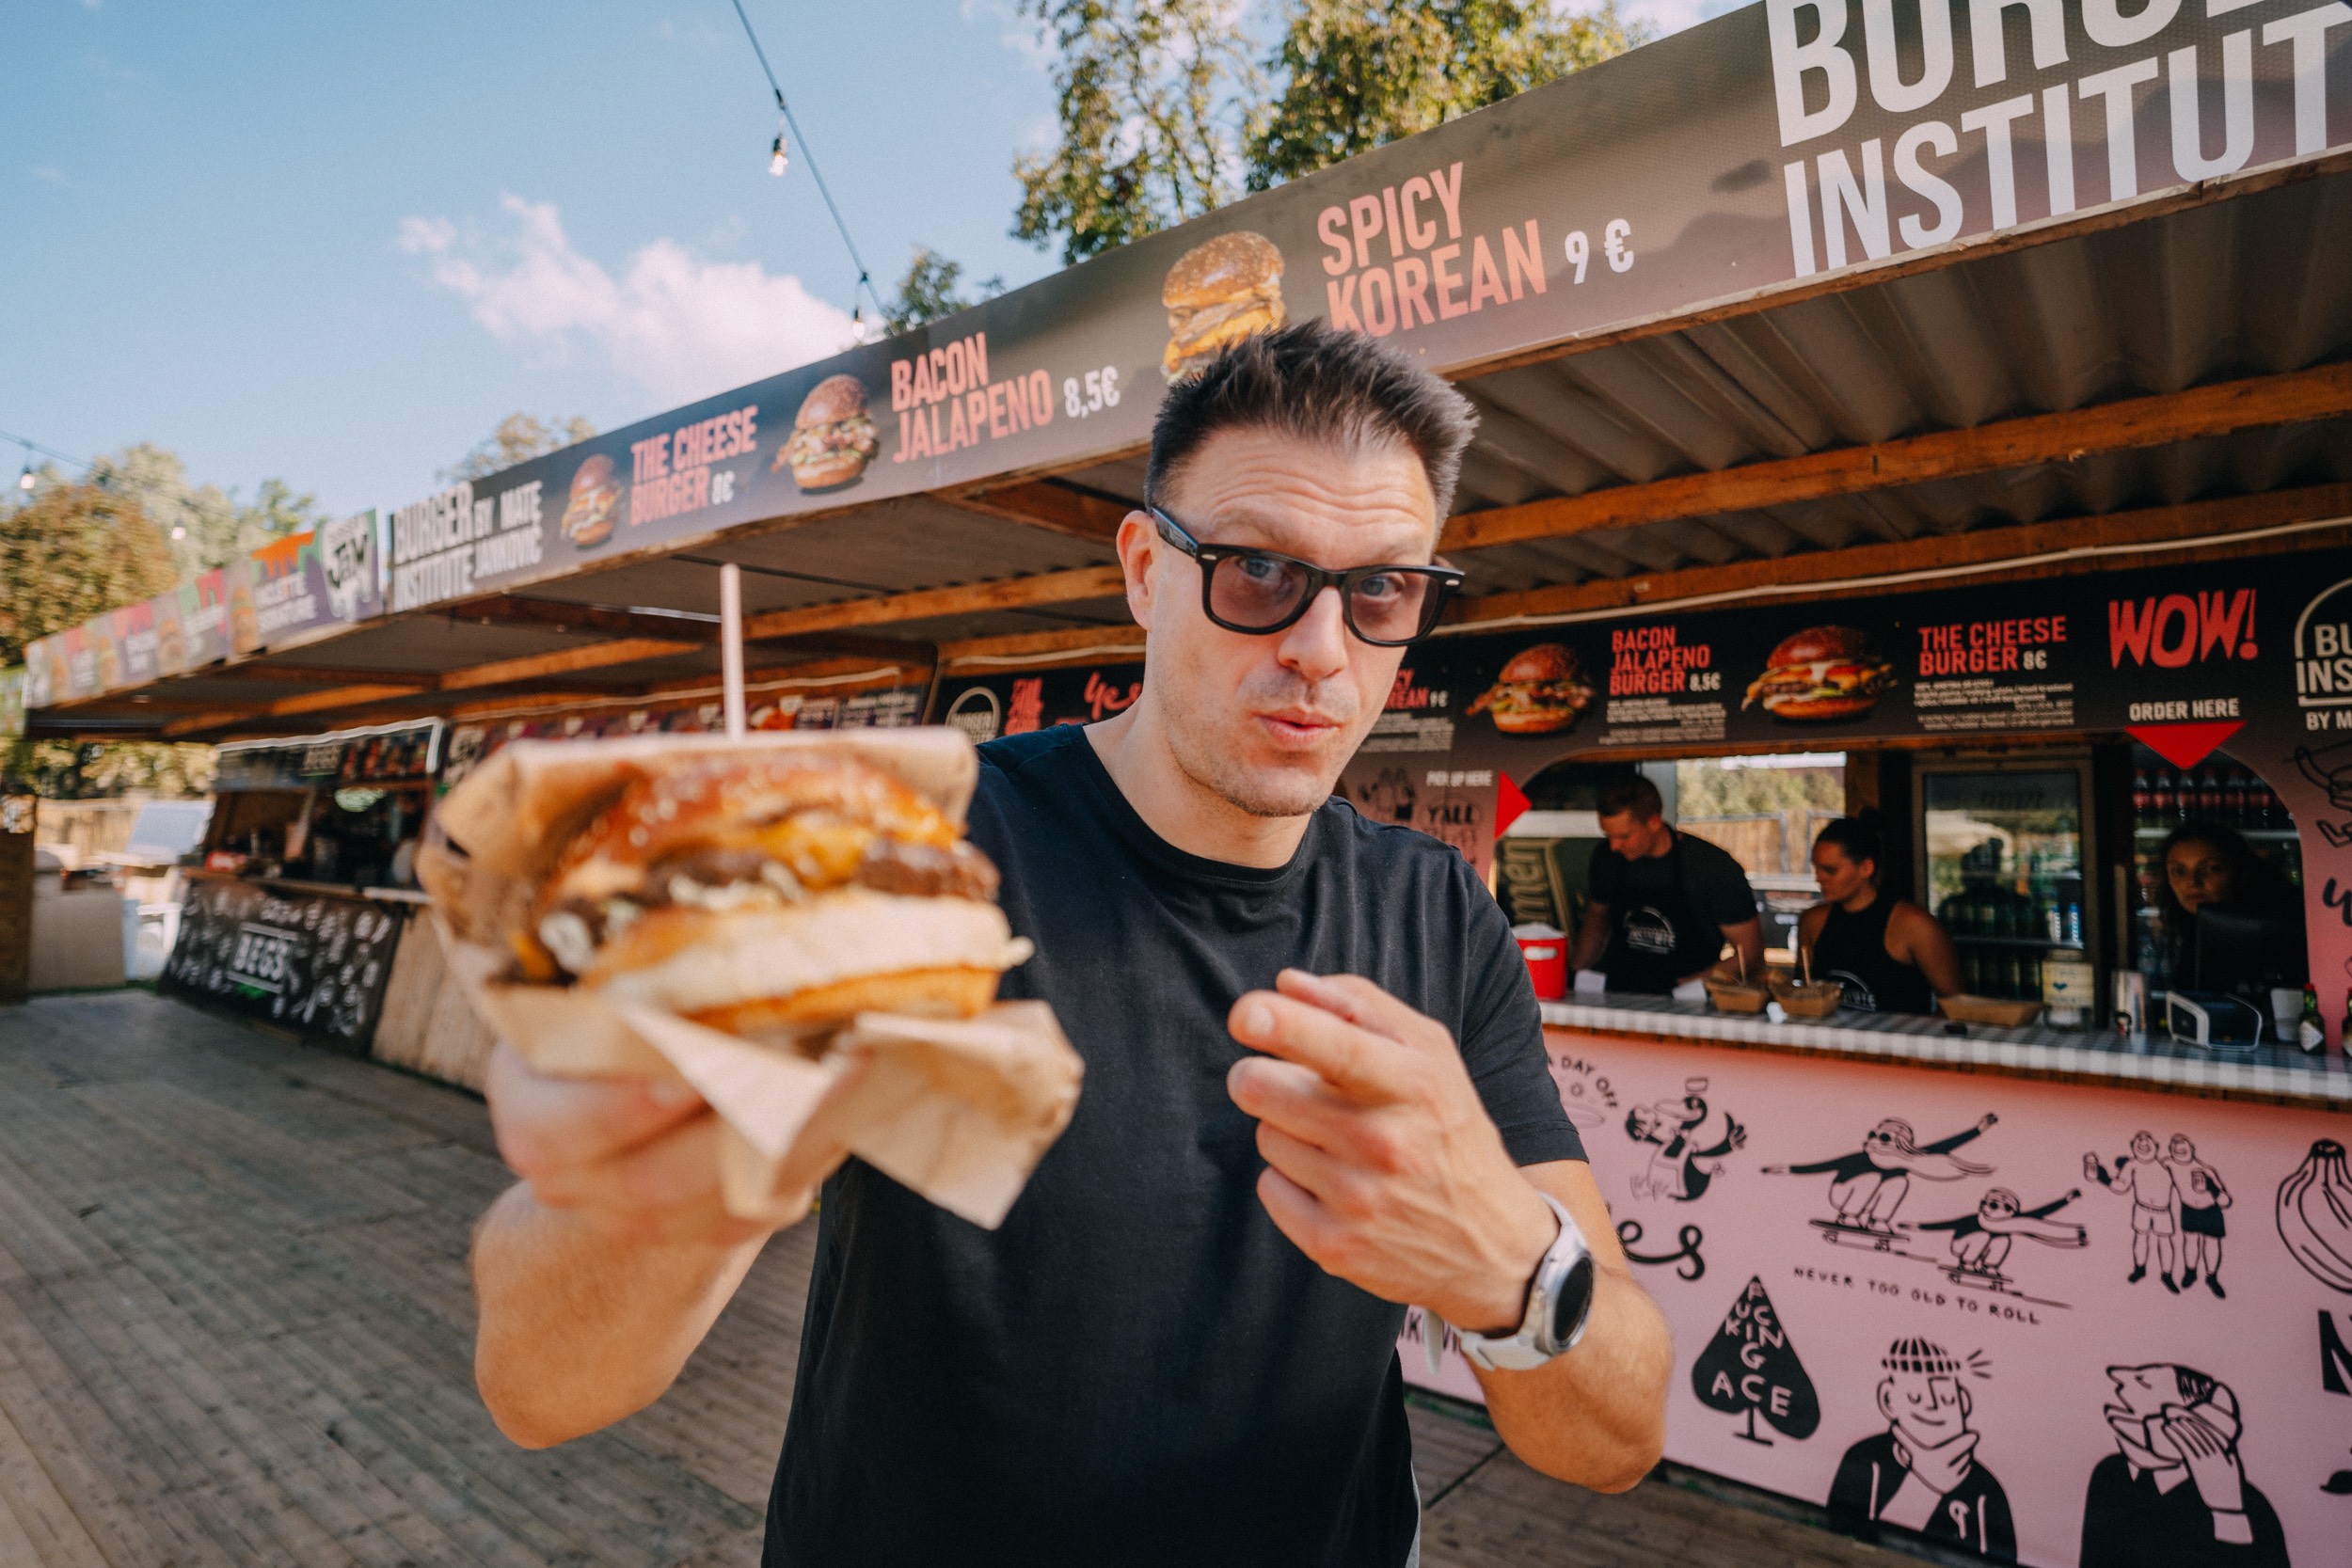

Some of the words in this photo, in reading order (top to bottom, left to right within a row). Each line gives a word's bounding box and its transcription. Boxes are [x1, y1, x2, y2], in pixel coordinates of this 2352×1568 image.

[1767, 0, 2258, 147] BUR
[1784, 2, 2352, 278] INSTITUT
[1317, 162, 1464, 277] SPICY
[1327, 218, 1547, 338] KOREAN
[1565, 230, 1589, 284] 9
[1604, 218, 1634, 273] €
[891, 331, 988, 412] BACON
[630, 433, 671, 483] THE
[673, 404, 758, 470] CHEESE
[893, 369, 1054, 464] JALAPENO
[1063, 365, 1120, 419] 8,5€
[393, 480, 474, 564] BURGER
[629, 466, 710, 527] BURGER
[1612, 625, 1676, 652] BACON
[1614, 644, 1710, 672] JALAPENO
[1918, 626, 1963, 650] THE
[1969, 615, 2067, 647] CHEESE
[2108, 589, 2258, 670] WOW!
[1610, 667, 1685, 696] BURGER
[1918, 645, 2018, 676] BURGER
[2024, 650, 2047, 670] 8€
[2129, 701, 2188, 721] ORDER
[2192, 697, 2240, 718] HERE
[2306, 711, 2330, 731] BY
[1561, 1055, 1594, 1075] DAY
[1794, 1267, 1853, 1288] NEVER
[1867, 1279, 1899, 1296] TOO
[1911, 1288, 1947, 1307] OLD
[1957, 1296, 1979, 1312] TO
[1989, 1304, 2040, 1325] ROLL
[1711, 1370, 1792, 1418] ACE
